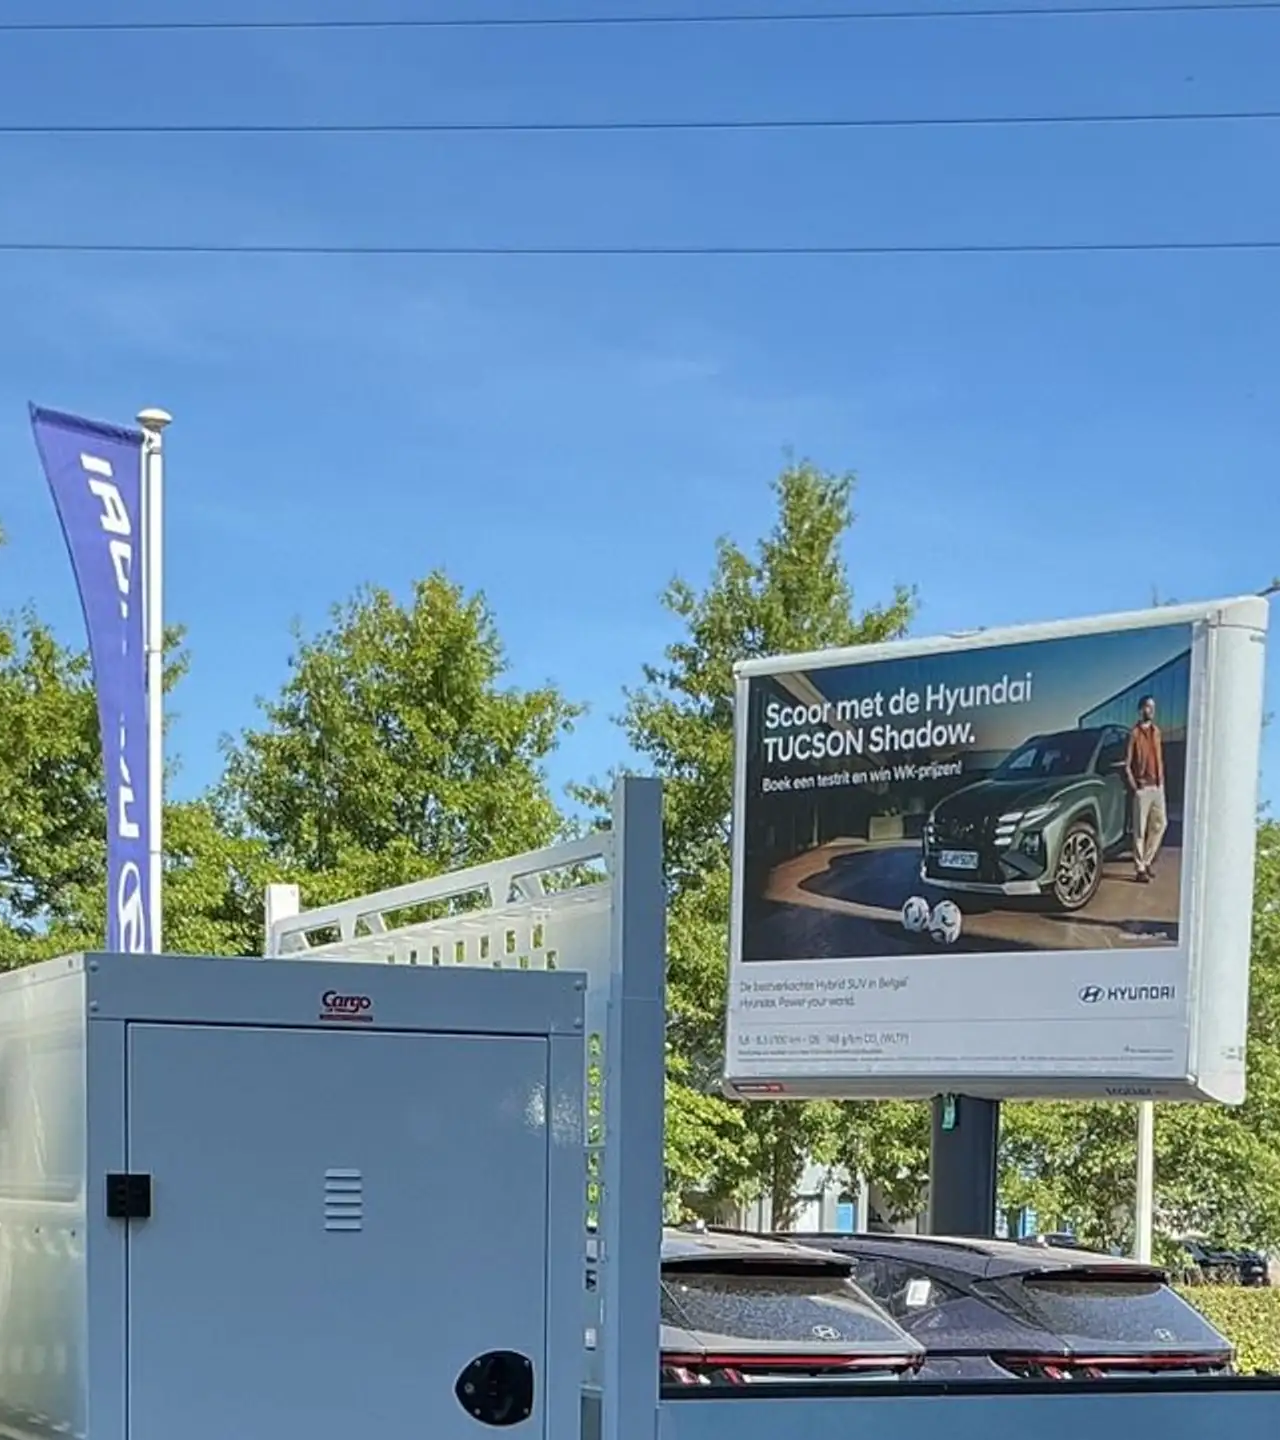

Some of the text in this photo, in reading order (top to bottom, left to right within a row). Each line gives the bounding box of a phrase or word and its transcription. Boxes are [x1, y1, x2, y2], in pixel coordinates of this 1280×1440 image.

[765, 672, 1033, 729] Scoor met de Hyundai
[763, 720, 976, 763] TUCSON Shadow.
[762, 759, 962, 792] Boek een testrit en win WK-prijzen!
[322, 990, 372, 1013] Cargo
[1107, 985, 1176, 1000] HYUNDAI
